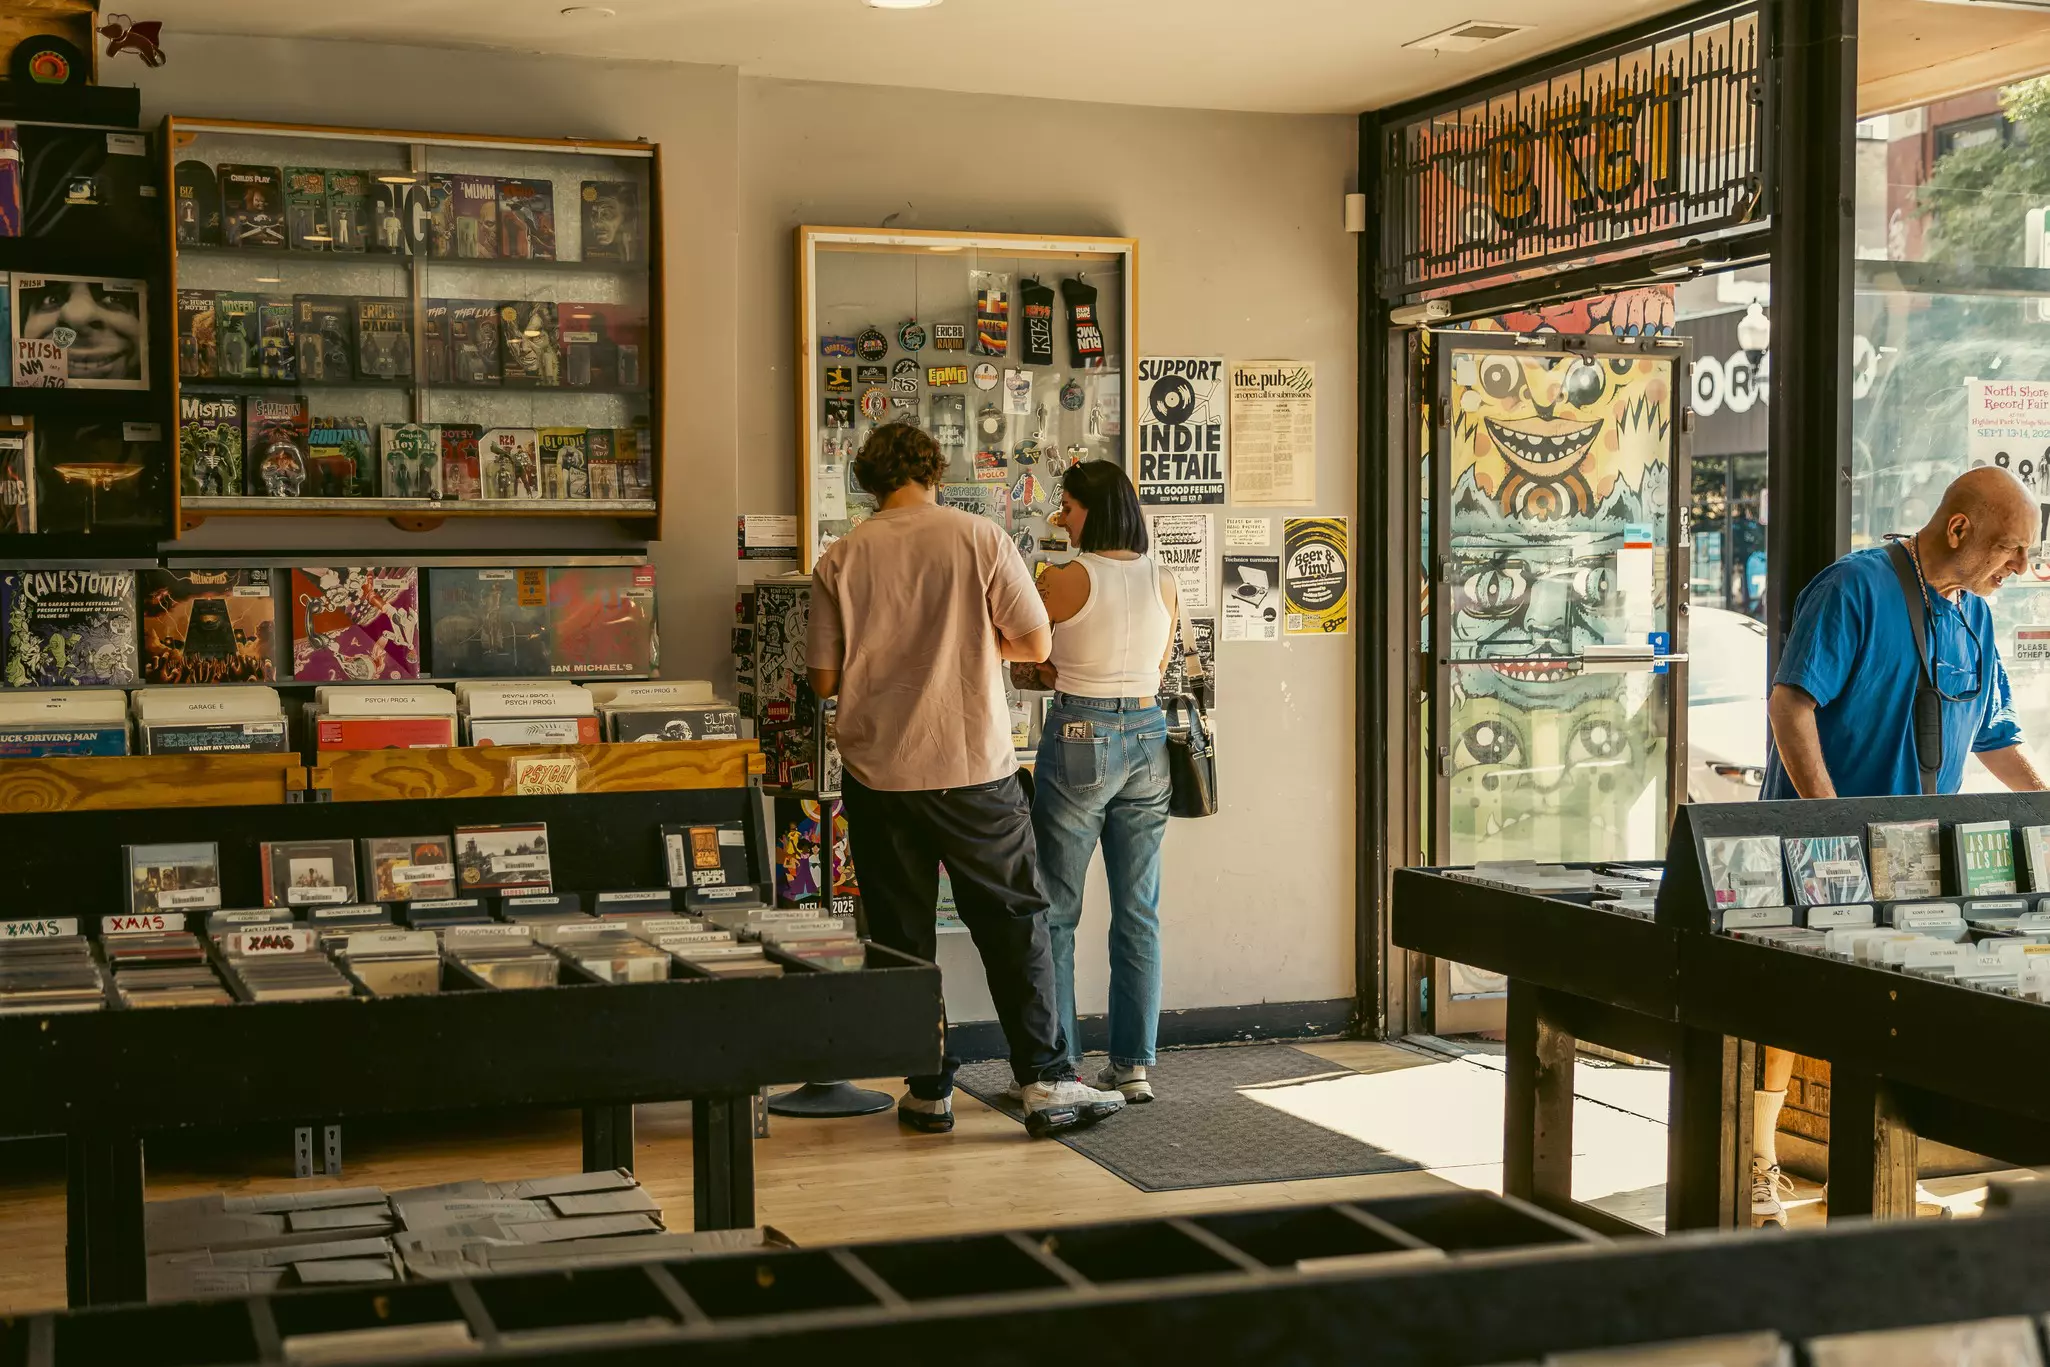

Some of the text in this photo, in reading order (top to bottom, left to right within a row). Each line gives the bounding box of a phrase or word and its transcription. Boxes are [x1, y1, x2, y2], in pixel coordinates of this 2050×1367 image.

[19, 279, 43, 287] PHISH
[454, 307, 497, 318] THEY LIVE
[936, 326, 952, 337] ERIC
[983, 320, 1002, 331] VHS
[19, 341, 62, 360] PHISH
[19, 359, 44, 376] NM
[1138, 359, 1222, 382] SUPPORT
[1243, 392, 1259, 401] open
[1259, 390, 1268, 399] call
[1984, 384, 2049, 397] North Shore
[181, 398, 238, 420] MISFITS
[255, 399, 301, 417] SAMHAIN
[1984, 398, 2049, 411] Record Fair
[1972, 418, 1999, 428] Highland
[2000, 418, 2015, 426] Park
[308, 428, 372, 445] GODZILLA
[499, 434, 516, 446] RZA
[1139, 424, 1221, 452] INDIE
[1977, 429, 2005, 438] SEPT
[388, 439, 415, 451] Hey
[544, 434, 585, 449] BLONDIE
[1139, 453, 1222, 481] RETAIL
[977, 470, 1005, 479] APOLLO
[1140, 484, 1223, 495] IT'S A GOOD FEELING
[1294, 549, 1335, 568] Beer &
[1298, 561, 1333, 578] Vinyl
[23, 570, 133, 603] CAVESTOMP!
[2017, 643, 2048, 651] PLEASE
[574, 663, 633, 672] MICHAEL'S
[24, 733, 72, 743] DRIVING
[73, 732, 98, 741] MAN
[832, 900, 854, 913] 2025
[112, 915, 166, 932] XMAS
[457, 927, 506, 936] SOUNDTRACKS
[248, 935, 295, 951] XMAS
[1979, 957, 1994, 965] JAZZ
